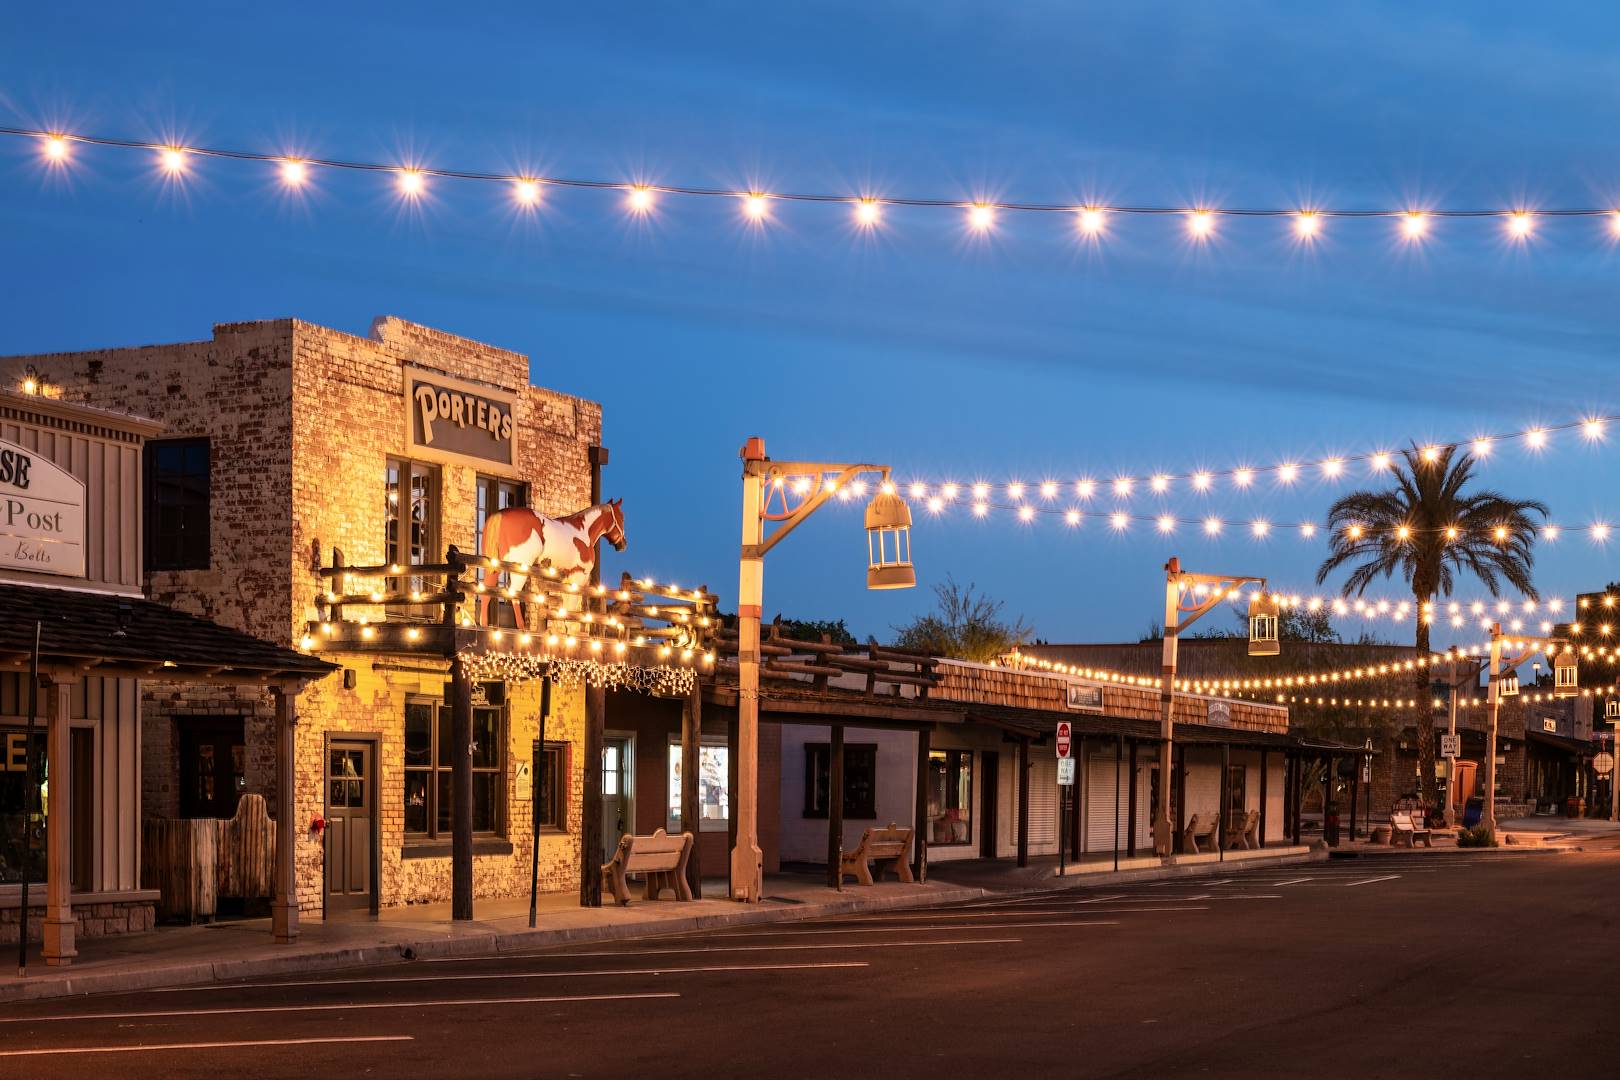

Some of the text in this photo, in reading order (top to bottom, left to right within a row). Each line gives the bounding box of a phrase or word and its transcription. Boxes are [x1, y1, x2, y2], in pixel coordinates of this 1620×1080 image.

[415, 386, 512, 445] PORTERS
[0, 447, 31, 489] SE
[6, 500, 63, 533] Post
[0, 733, 27, 771] E
